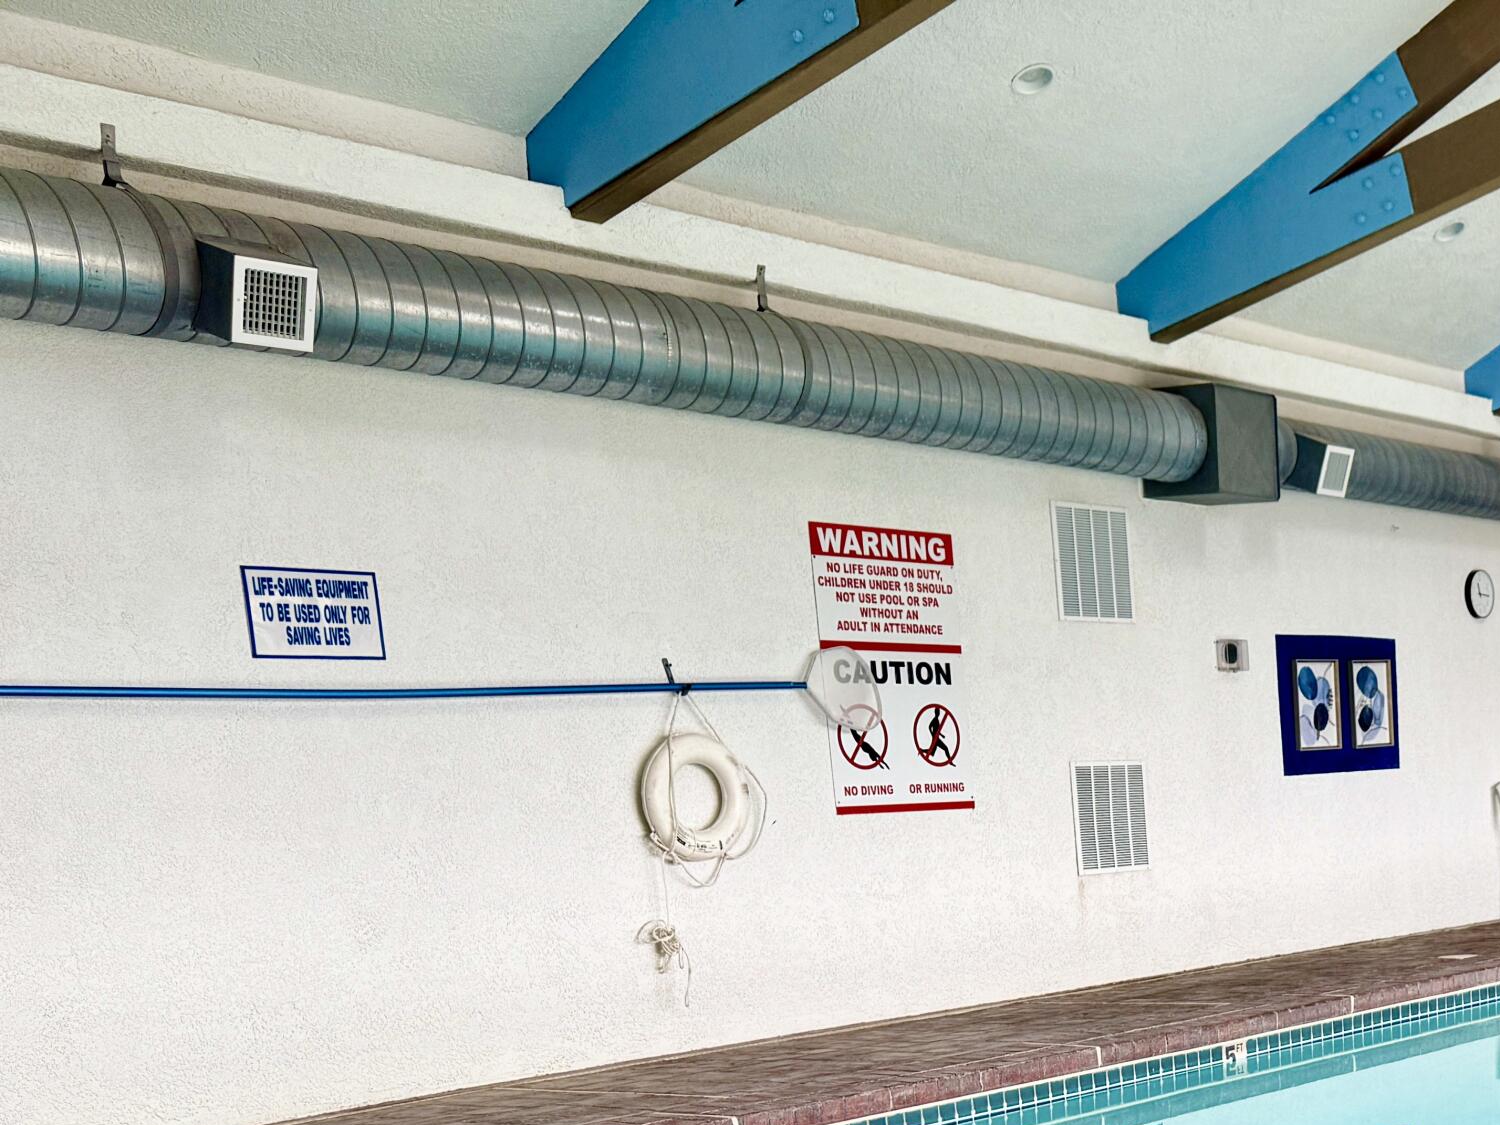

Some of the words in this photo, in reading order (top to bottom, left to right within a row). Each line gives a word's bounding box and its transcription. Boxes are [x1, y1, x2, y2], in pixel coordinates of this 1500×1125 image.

[816, 527, 946, 562] WARNING
[826, 562, 840, 573] NO
[844, 563, 864, 574] LIFE
[867, 565, 898, 577] GUARD
[902, 567, 914, 578] ON
[917, 569, 943, 581] DUTY,
[252, 576, 313, 597] LIFE-SAVING
[316, 579, 369, 599] EQUIPMENT
[818, 576, 866, 589] CHILDREN
[869, 579, 901, 591] UNDER
[904, 582, 914, 592] 18
[917, 583, 953, 595] SHOULD
[836, 592, 856, 602] NOT
[858, 593, 877, 604] USE
[880, 594, 904, 606] POOL
[907, 596, 920, 606] OR
[922, 597, 939, 608] SPA
[259, 602, 273, 621] TO
[277, 603, 291, 622] BE
[294, 604, 320, 623] USED
[324, 605, 347, 624] ONLY
[351, 606, 371, 625] FOR
[860, 607, 903, 619] WITHOUT
[906, 610, 919, 620] AN
[286, 626, 321, 646] SAVING
[324, 627, 350, 646] LIVES
[837, 621, 867, 632] ADULT
[871, 622, 881, 633] IN
[883, 623, 943, 635] ATTENDANCE
[833, 660, 952, 685] CAUTION
[844, 786, 858, 796] NO
[861, 785, 894, 796] DIVING
[909, 784, 922, 794] OR
[925, 782, 965, 793] RUNNING
